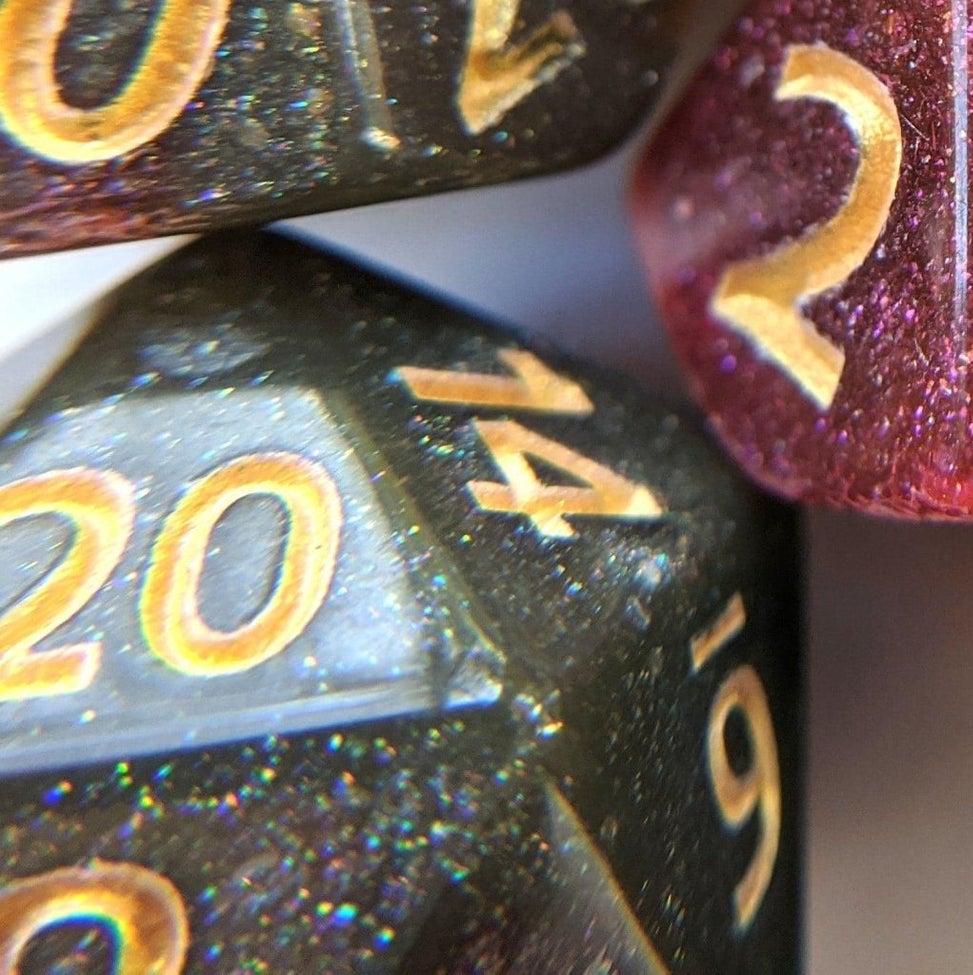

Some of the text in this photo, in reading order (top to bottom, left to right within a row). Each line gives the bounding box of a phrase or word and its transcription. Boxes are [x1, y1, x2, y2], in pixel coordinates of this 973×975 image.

[710, 44, 903, 410] 2
[395, 348, 664, 539] 14
[0, 450, 343, 701] 20
